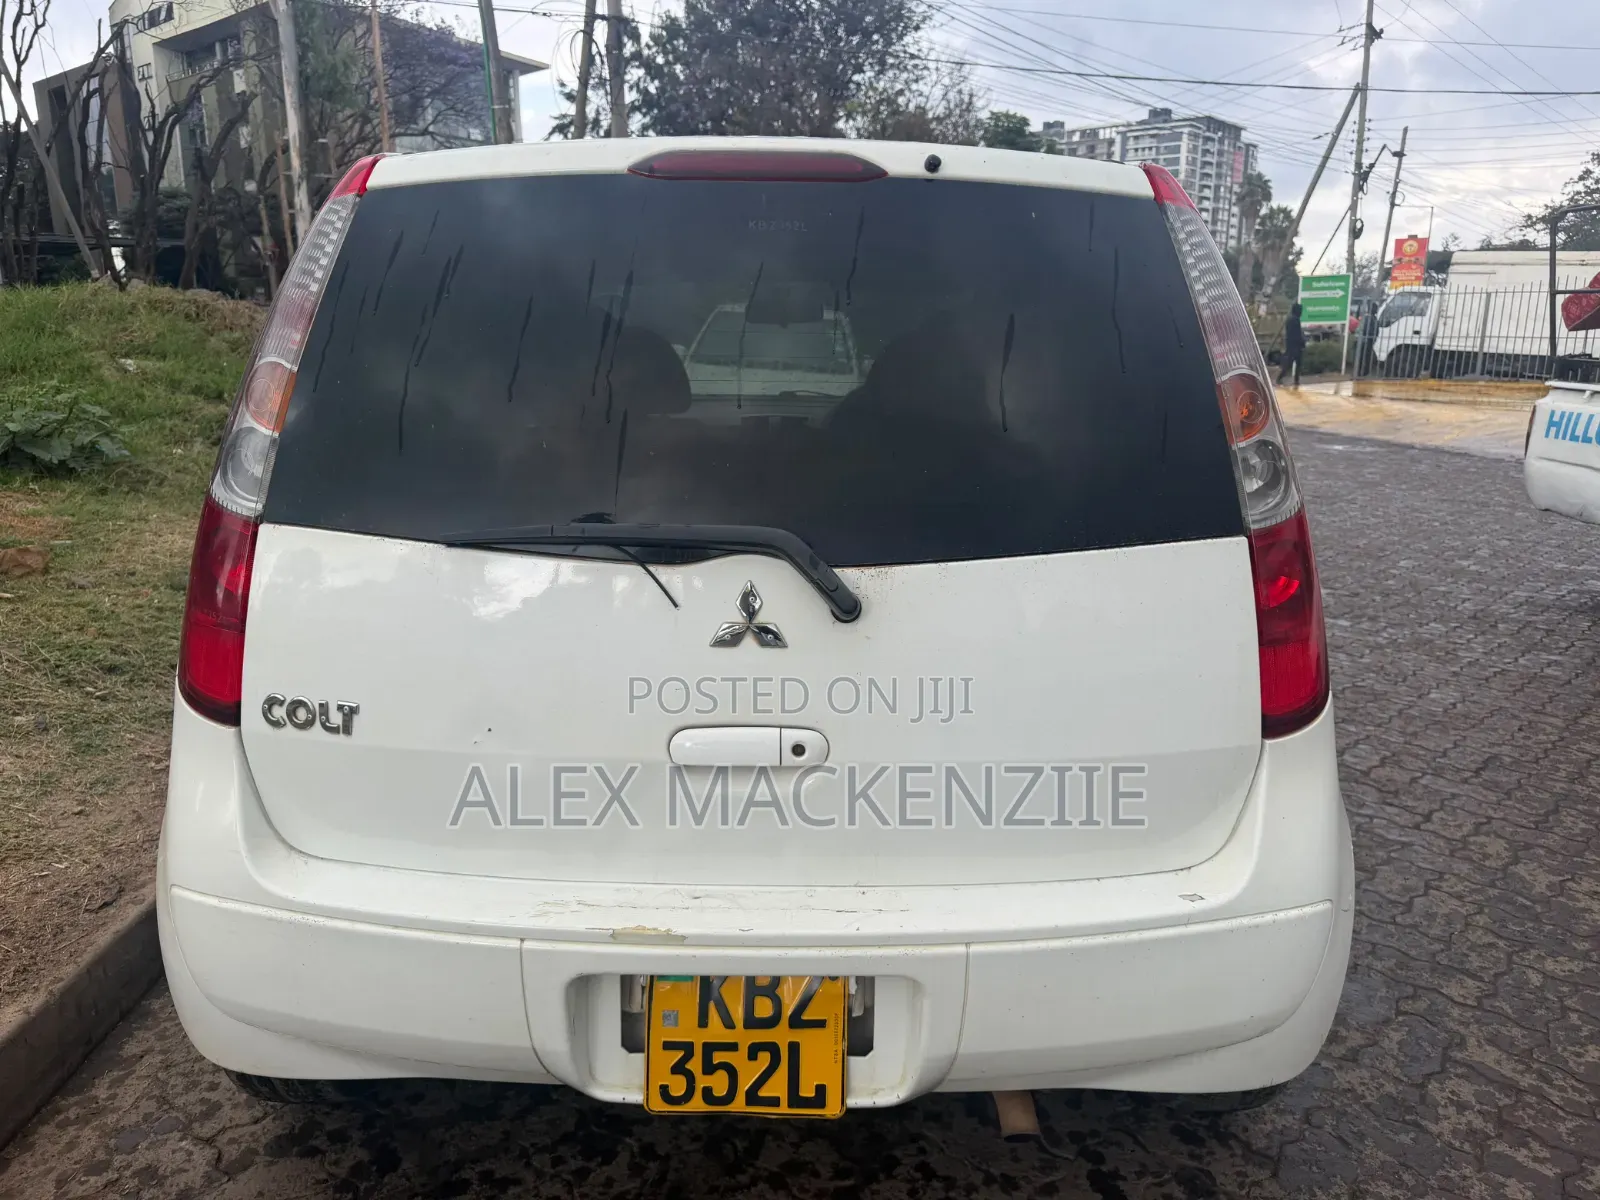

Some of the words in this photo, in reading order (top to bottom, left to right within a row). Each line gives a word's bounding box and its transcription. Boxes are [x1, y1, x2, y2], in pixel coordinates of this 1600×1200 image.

[1544, 409, 1600, 446] HILL
[261, 692, 360, 737] COLT
[697, 975, 828, 1029] KBZ
[658, 1041, 827, 1109] 352L
